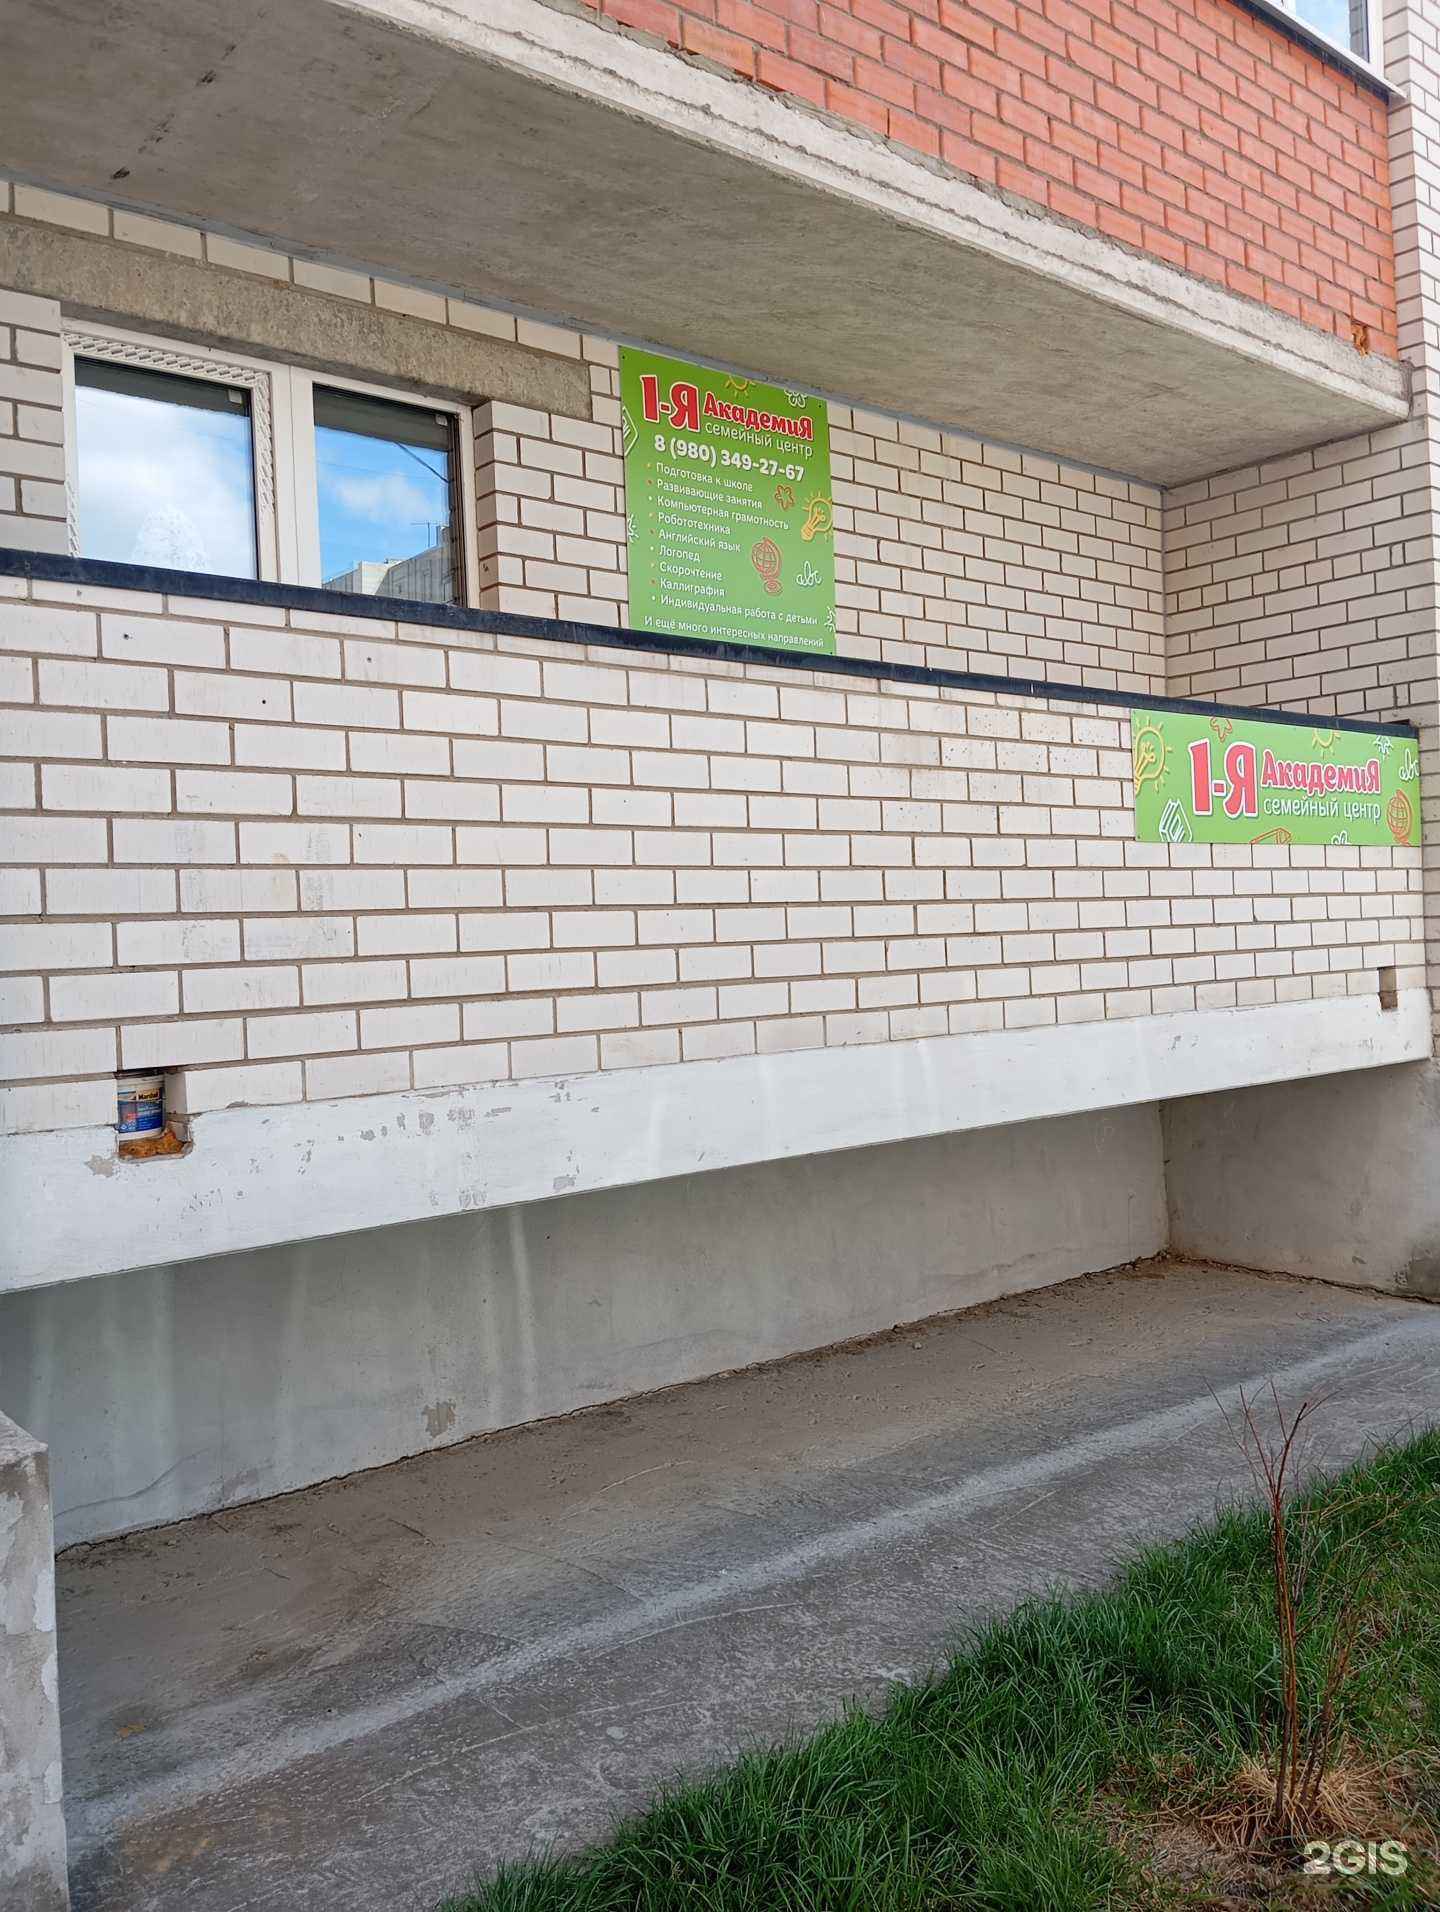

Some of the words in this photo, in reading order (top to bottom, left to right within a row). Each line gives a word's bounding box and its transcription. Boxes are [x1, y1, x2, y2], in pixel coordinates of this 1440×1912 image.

[640, 374, 701, 432] 1-Я
[705, 422, 773, 448] семейный
[776, 439, 813, 459] центр
[654, 435, 666, 451] 8
[670, 437, 717, 468] (980)
[720, 450, 804, 481] 349-27-67
[656, 462, 713, 484] Подготовка
[716, 477, 721, 486] к
[723, 479, 753, 492] школе
[657, 479, 724, 502] Развивающие
[726, 496, 763, 509] занятия
[657, 496, 729, 519] Компьютерная
[732, 511, 789, 530] грамотность
[658, 512, 731, 535] Робототехника
[659, 529, 716, 547] Английский
[718, 540, 742, 553] язык
[659, 545, 701, 562] Логопед
[659, 562, 723, 581] Скорочтение
[660, 578, 726, 597] Каллиграфия
[660, 595, 742, 616] Индивидуальная
[744, 607, 776, 620] работа
[778, 612, 784, 622] с
[785, 612, 818, 625] детьми
[644, 616, 653, 625] И
[655, 617, 676, 630] ещё
[678, 621, 708, 633] много
[710, 626, 766, 642] интересных
[768, 634, 824, 648] направлений
[1188, 738, 1258, 818] 1-Я
[1263, 797, 1340, 818] семейный
[1343, 802, 1381, 824] центр
